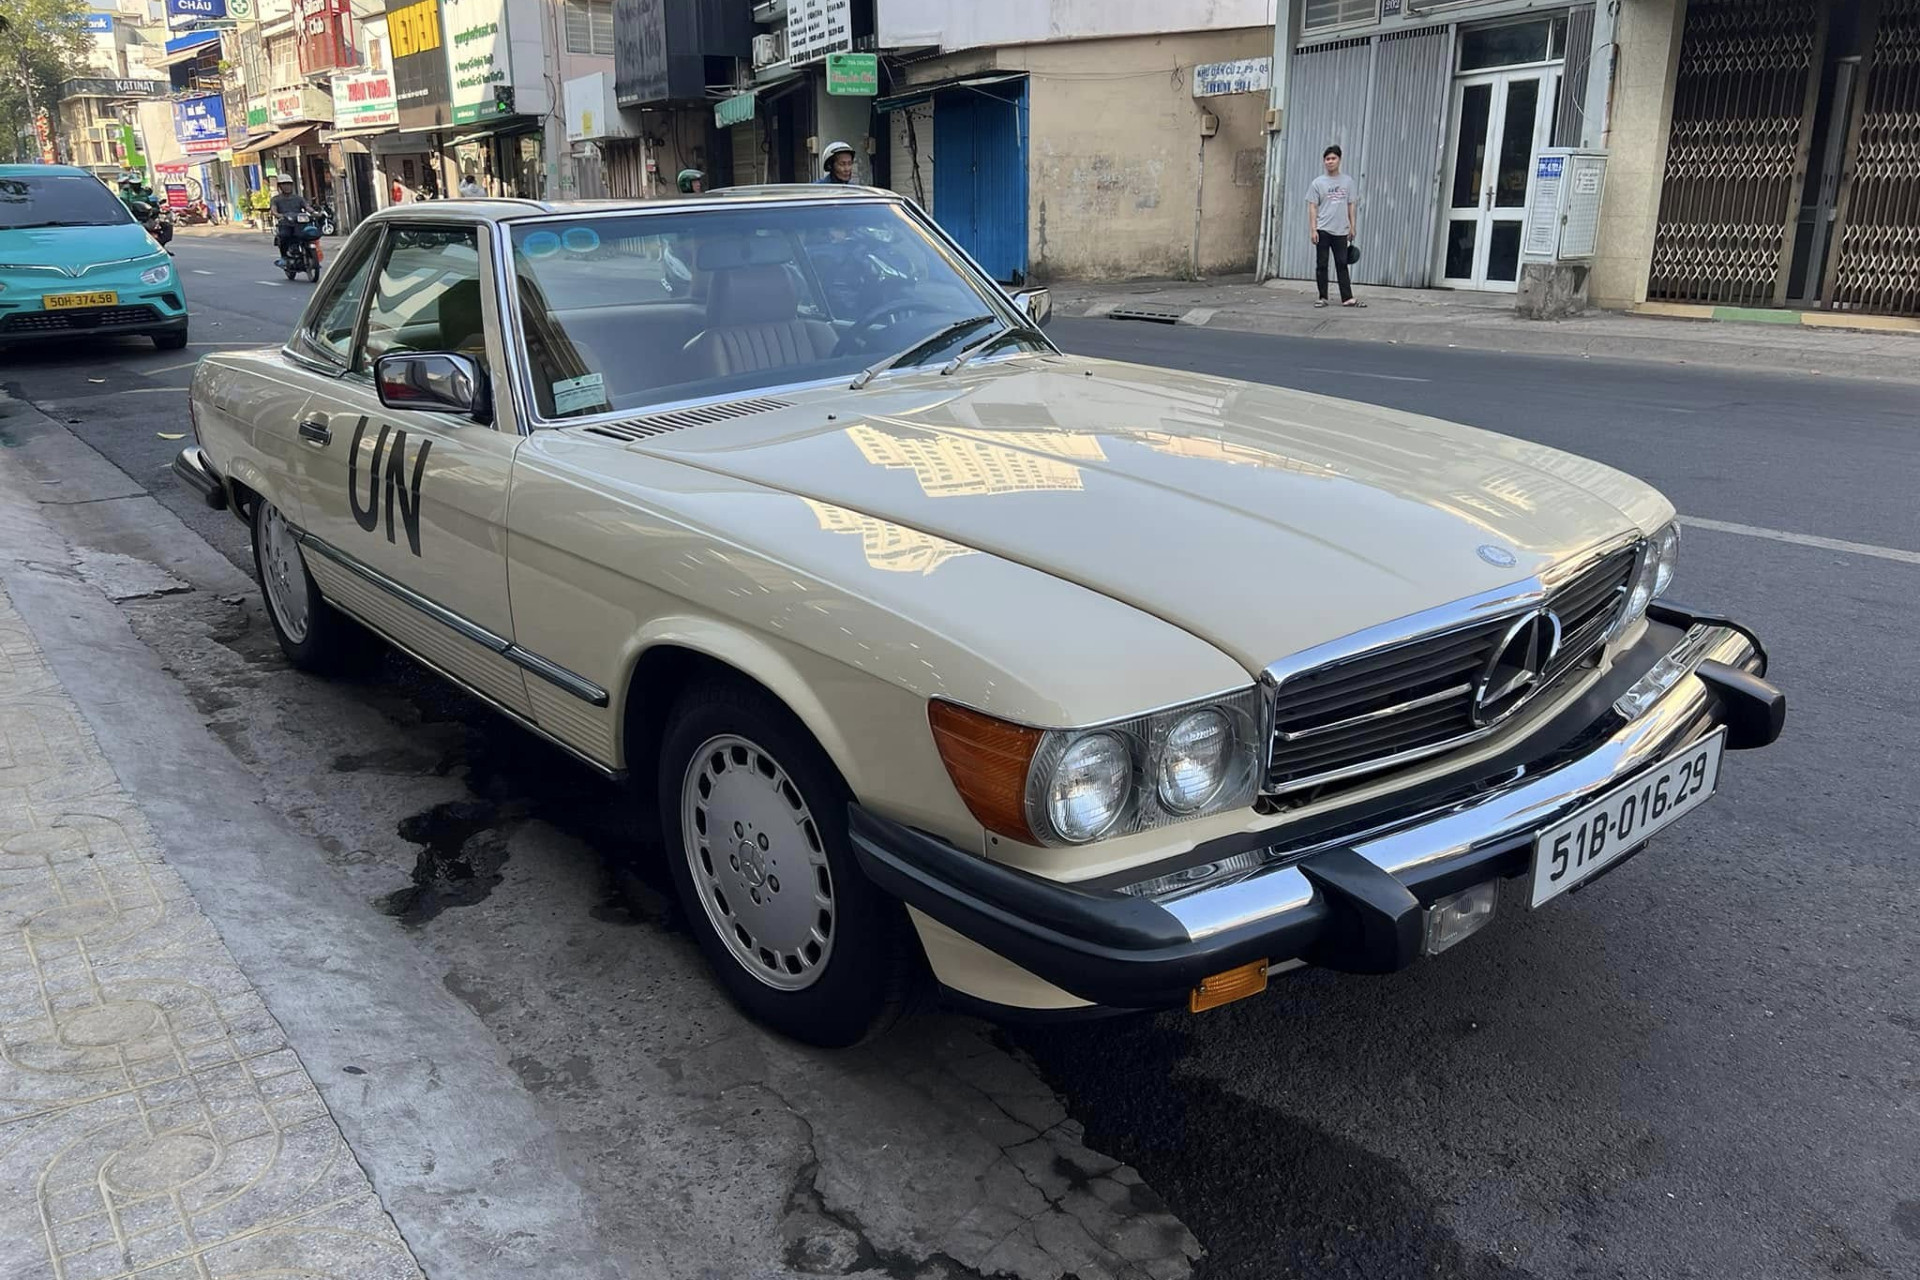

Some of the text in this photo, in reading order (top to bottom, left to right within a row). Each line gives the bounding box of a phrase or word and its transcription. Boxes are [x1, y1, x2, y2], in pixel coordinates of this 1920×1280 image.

[115, 81, 155, 93] KATINAT
[50, 293, 113, 308] 50H-374.58
[348, 415, 433, 557] UN
[1550, 751, 1708, 882] 51B-016.29
